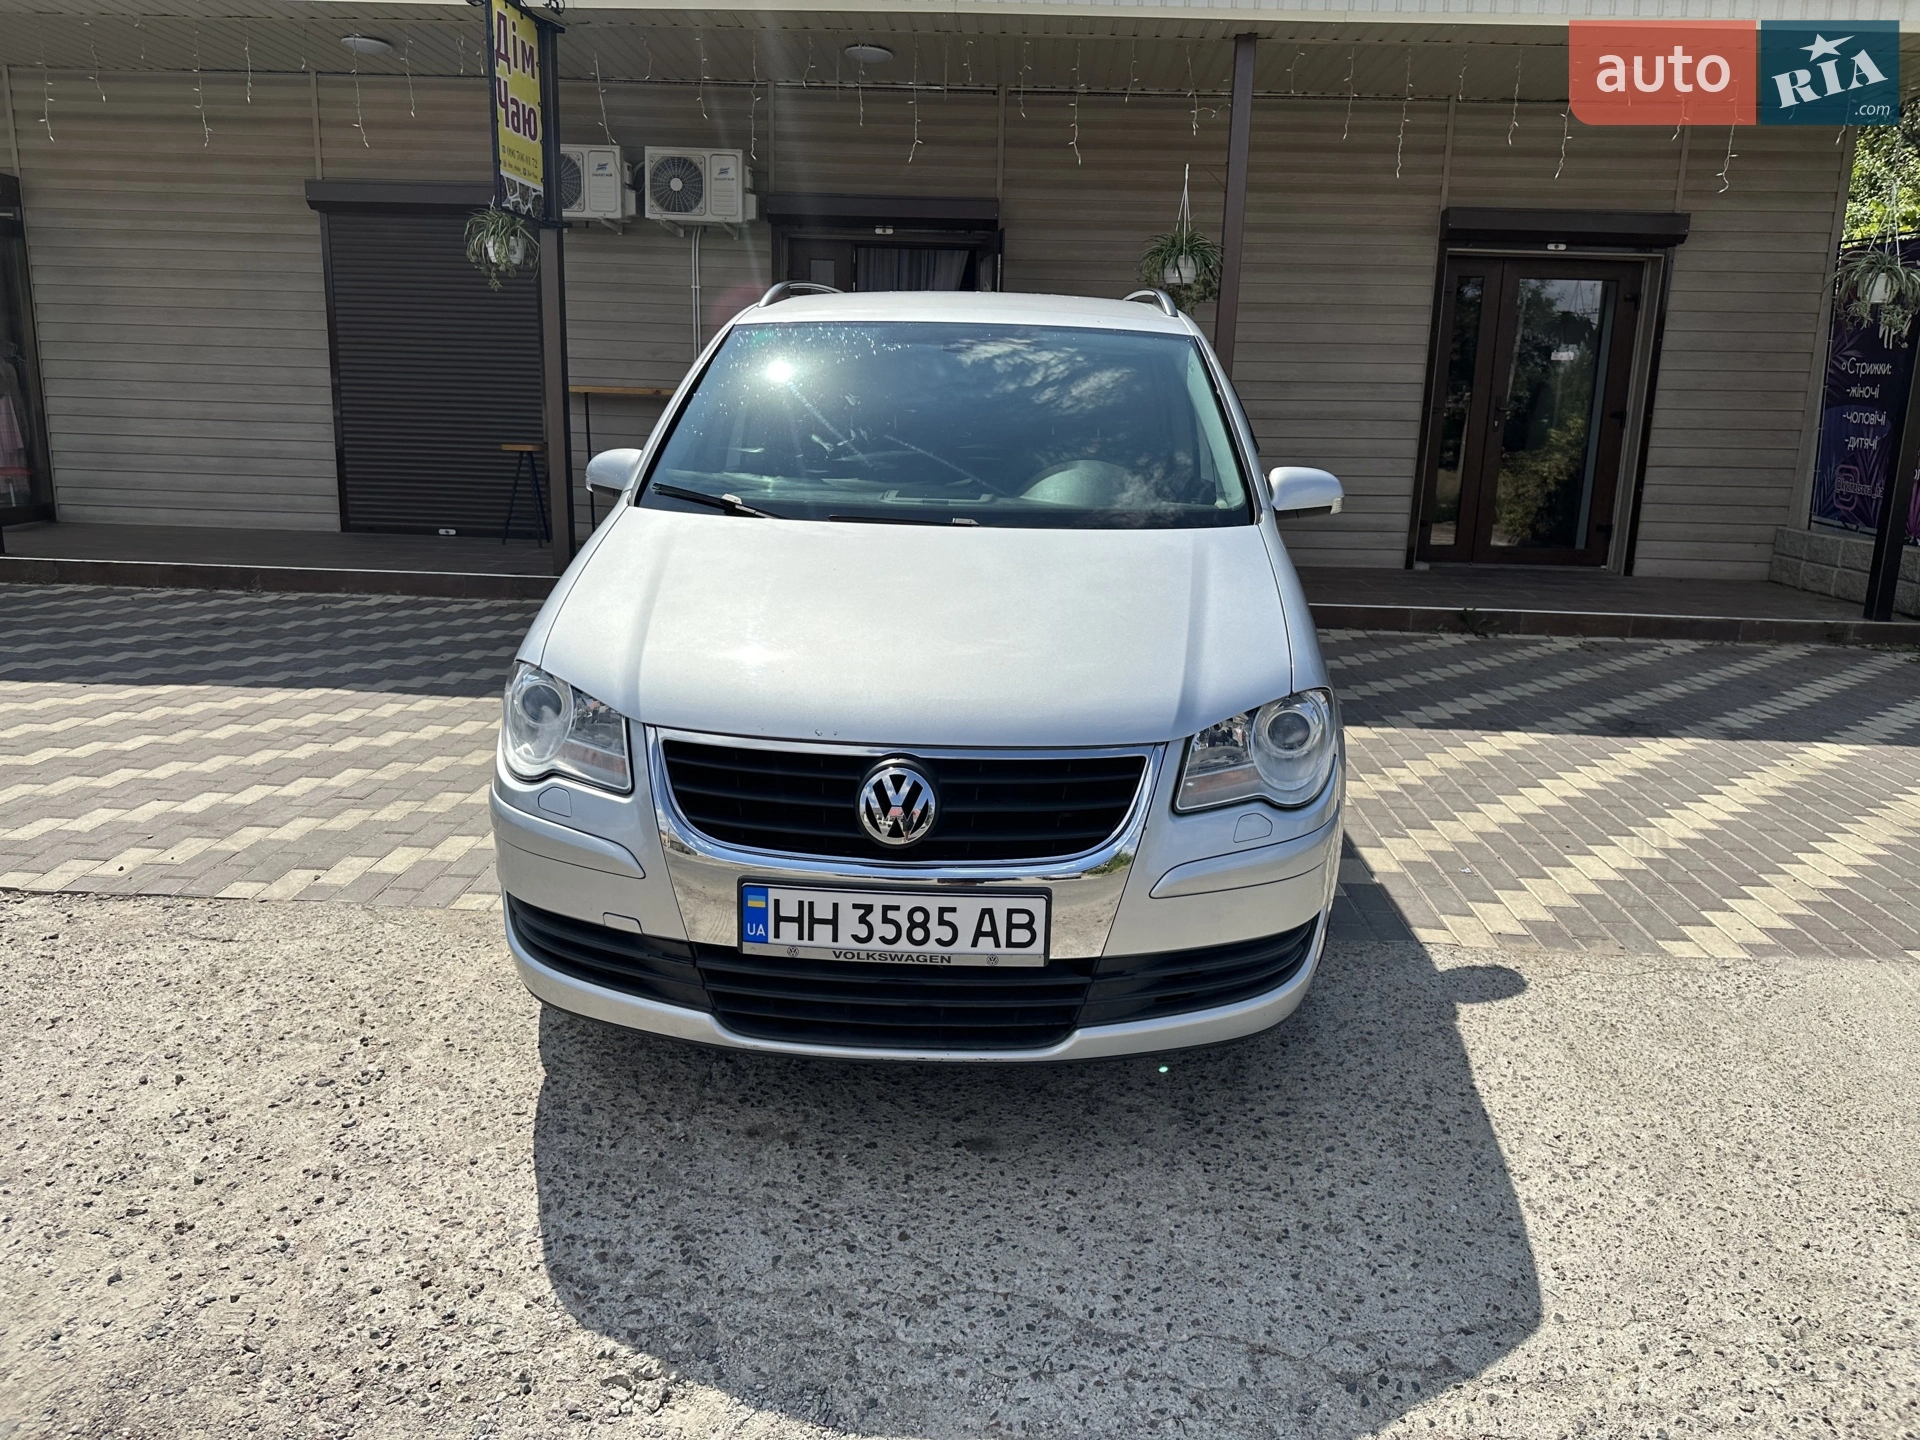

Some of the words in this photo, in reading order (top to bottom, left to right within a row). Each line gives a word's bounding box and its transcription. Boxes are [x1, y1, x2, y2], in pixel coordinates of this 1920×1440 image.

[495, 11, 536, 79] Дім
[495, 77, 538, 142] Чаю
[1847, 357, 1892, 378] Стрижки:
[1846, 384, 1880, 399] -жіночі
[1842, 410, 1886, 426] -чоловічі
[748, 923, 766, 937] UA
[773, 898, 839, 943] HH
[850, 903, 959, 946] 3585
[970, 907, 1037, 949] AB
[832, 950, 952, 964] VOLKSWAGEN
